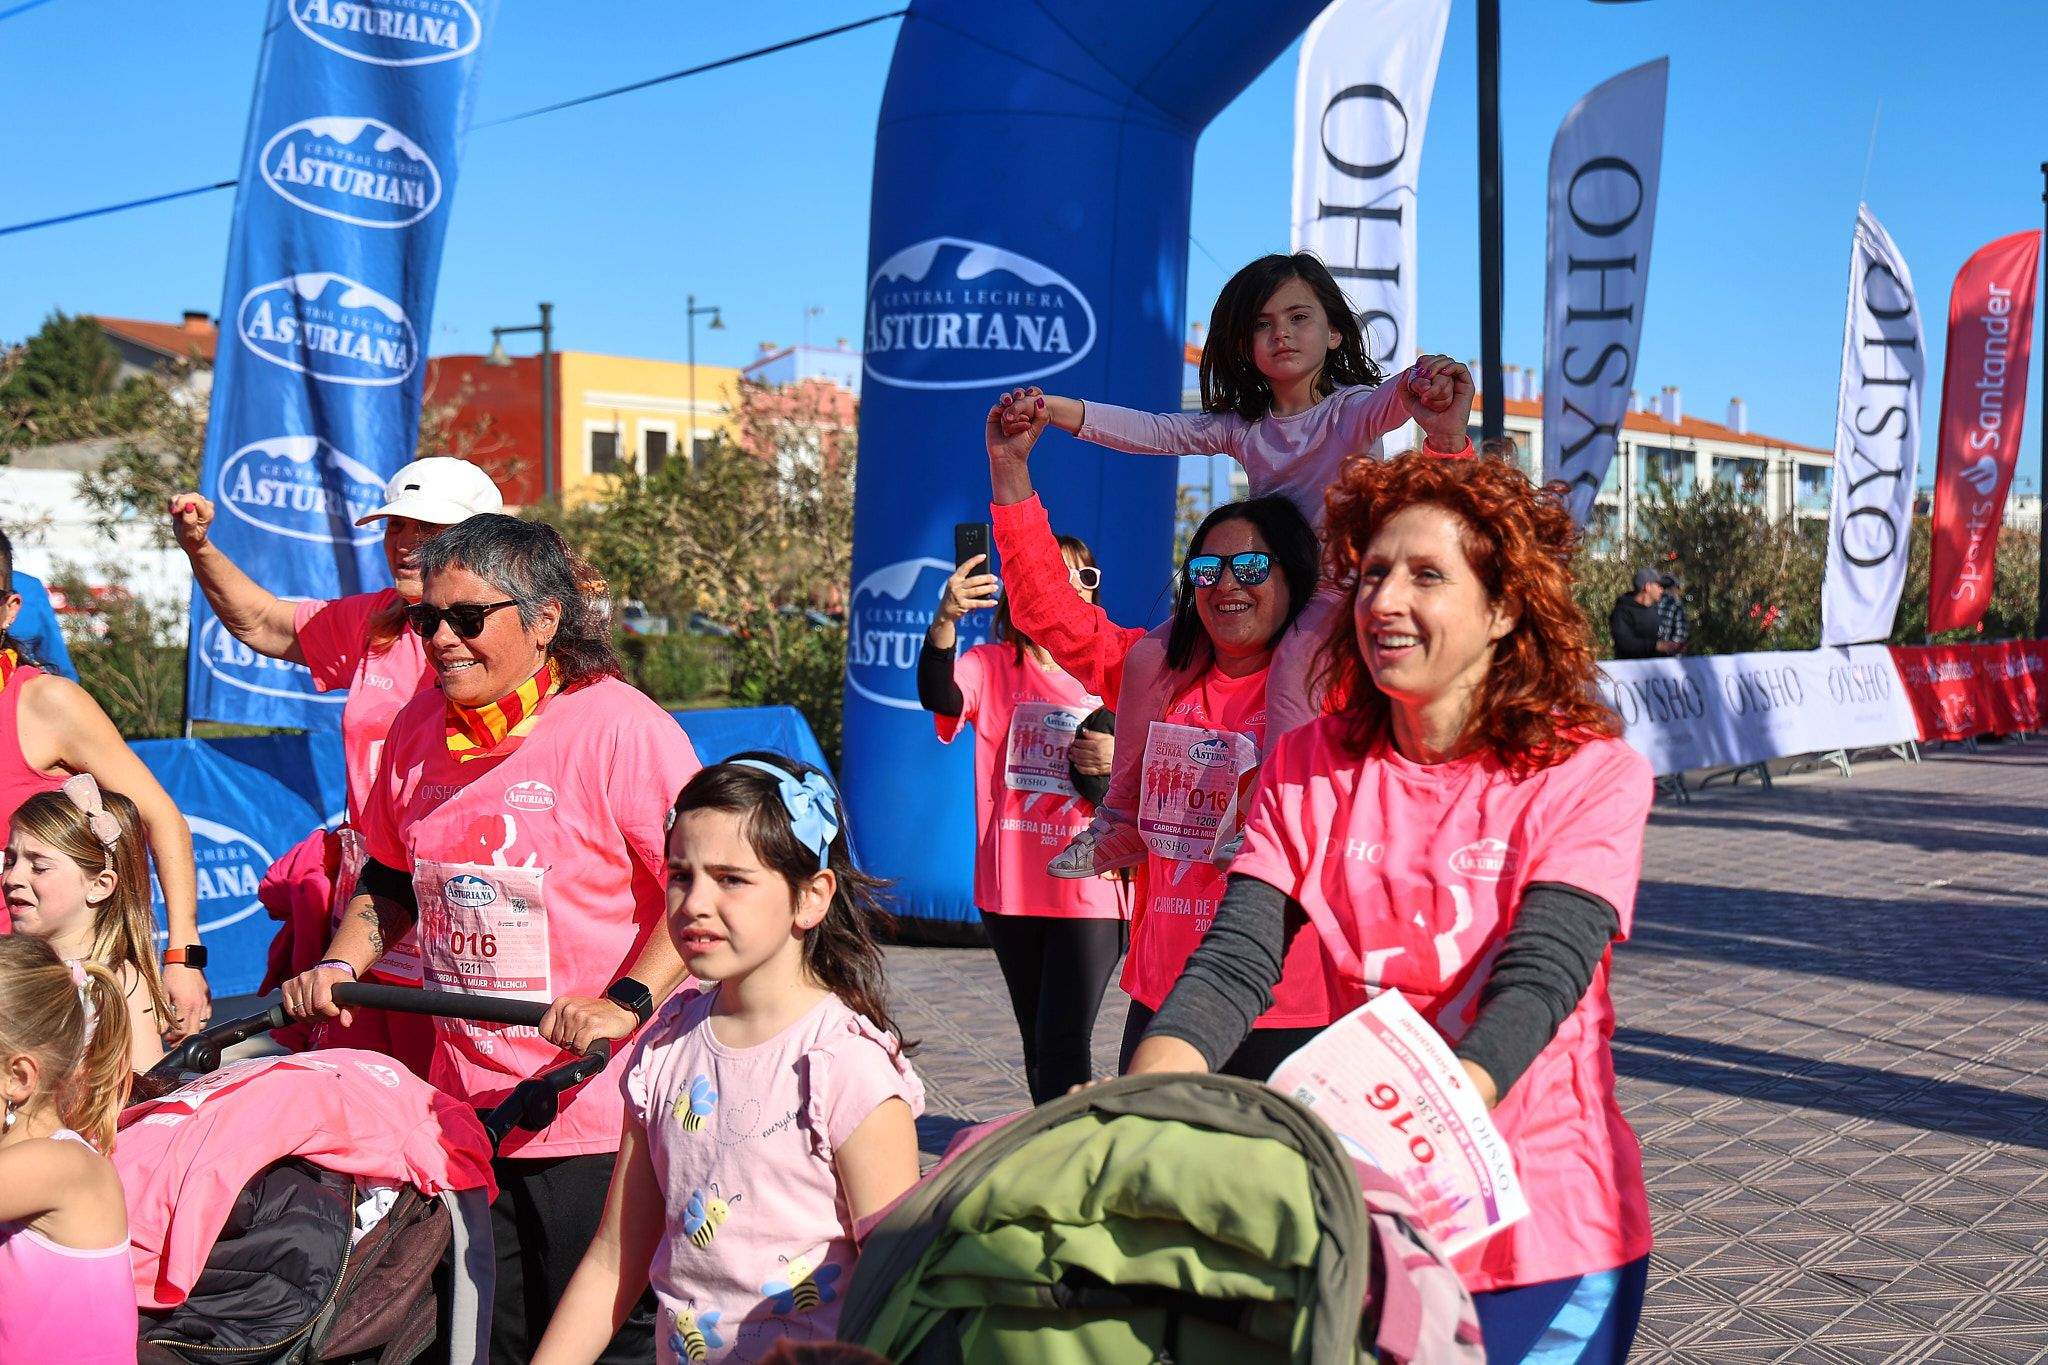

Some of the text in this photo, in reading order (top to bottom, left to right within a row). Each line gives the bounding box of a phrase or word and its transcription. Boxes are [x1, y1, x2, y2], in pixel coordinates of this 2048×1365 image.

[272, 141, 425, 209] ASTURIANA
[884, 289, 1065, 309] CENTRAL LECHERA
[866, 300, 1072, 353] ASTURIANA
[1841, 263, 1917, 568] OYSHO
[1951, 281, 2013, 602] Sports Santander
[1725, 665, 1804, 717] OYSHO
[1828, 662, 1890, 705] OYSHO
[1613, 674, 1706, 727] OYSHO
[1155, 746, 1182, 758] SUMA
[1016, 776, 1047, 787] OYSHO
[508, 790, 554, 805] ASTURIANA
[1188, 788, 1228, 812] 016
[1041, 822, 1054, 835] DE
[1055, 825, 1067, 837] LA
[1153, 822, 1182, 834] CARRERA
[1183, 828, 1191, 836] DE
[1195, 815, 1217, 828] 1208
[1150, 837, 1190, 853] OYSHO
[447, 885, 493, 901] ASTURIANA
[1154, 895, 1191, 915] CARRERA
[1194, 899, 1210, 916] DE
[450, 930, 497, 958] 016
[459, 962, 481, 975] 1211
[467, 978, 488, 988] MUJER
[493, 980, 528, 989] VALENCIA
[1365, 1082, 1435, 1163] 016
[1472, 1116, 1510, 1191] OYSHO
